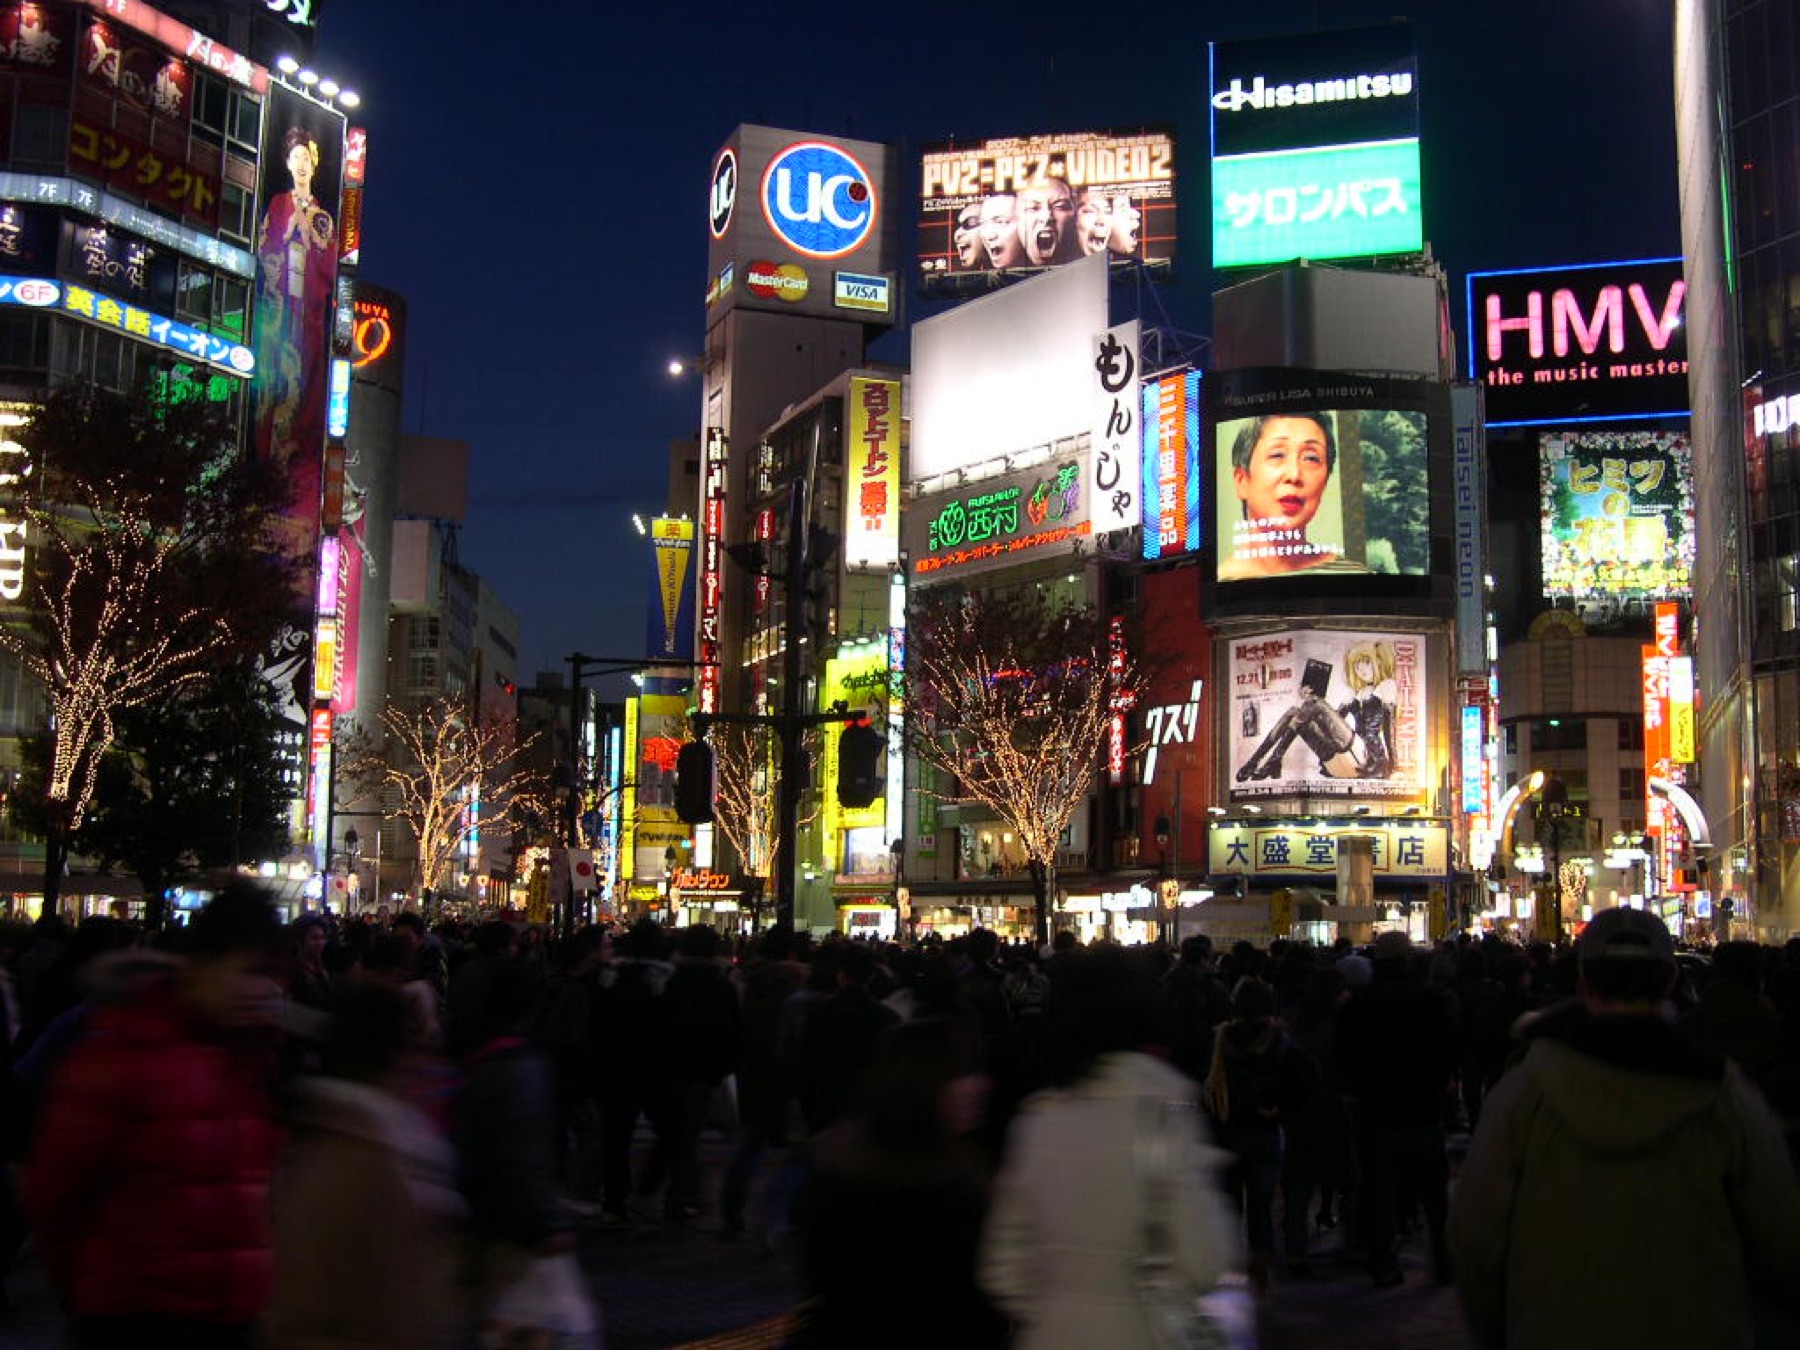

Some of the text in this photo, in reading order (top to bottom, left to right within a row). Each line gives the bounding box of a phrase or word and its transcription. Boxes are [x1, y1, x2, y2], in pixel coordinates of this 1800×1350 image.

[1212, 73, 1412, 111] Hisamitsu
[71, 121, 215, 210] コンタクト
[38, 183, 57, 196] 7F
[78, 190, 94, 206] 7F
[777, 168, 866, 229] UC
[1223, 177, 1407, 229] サロンパス
[20, 284, 52, 300] 6F
[748, 272, 808, 291] MasterCard
[845, 284, 878, 300] VISA
[1486, 280, 1687, 361] HMV
[1488, 367, 1525, 386] the
[1534, 361, 1599, 383] music
[1568, 458, 1666, 495] ヒミツ
[1602, 491, 1631, 516] の
[1460, 521, 1475, 599] neon
[1143, 680, 1203, 785] クスリ
